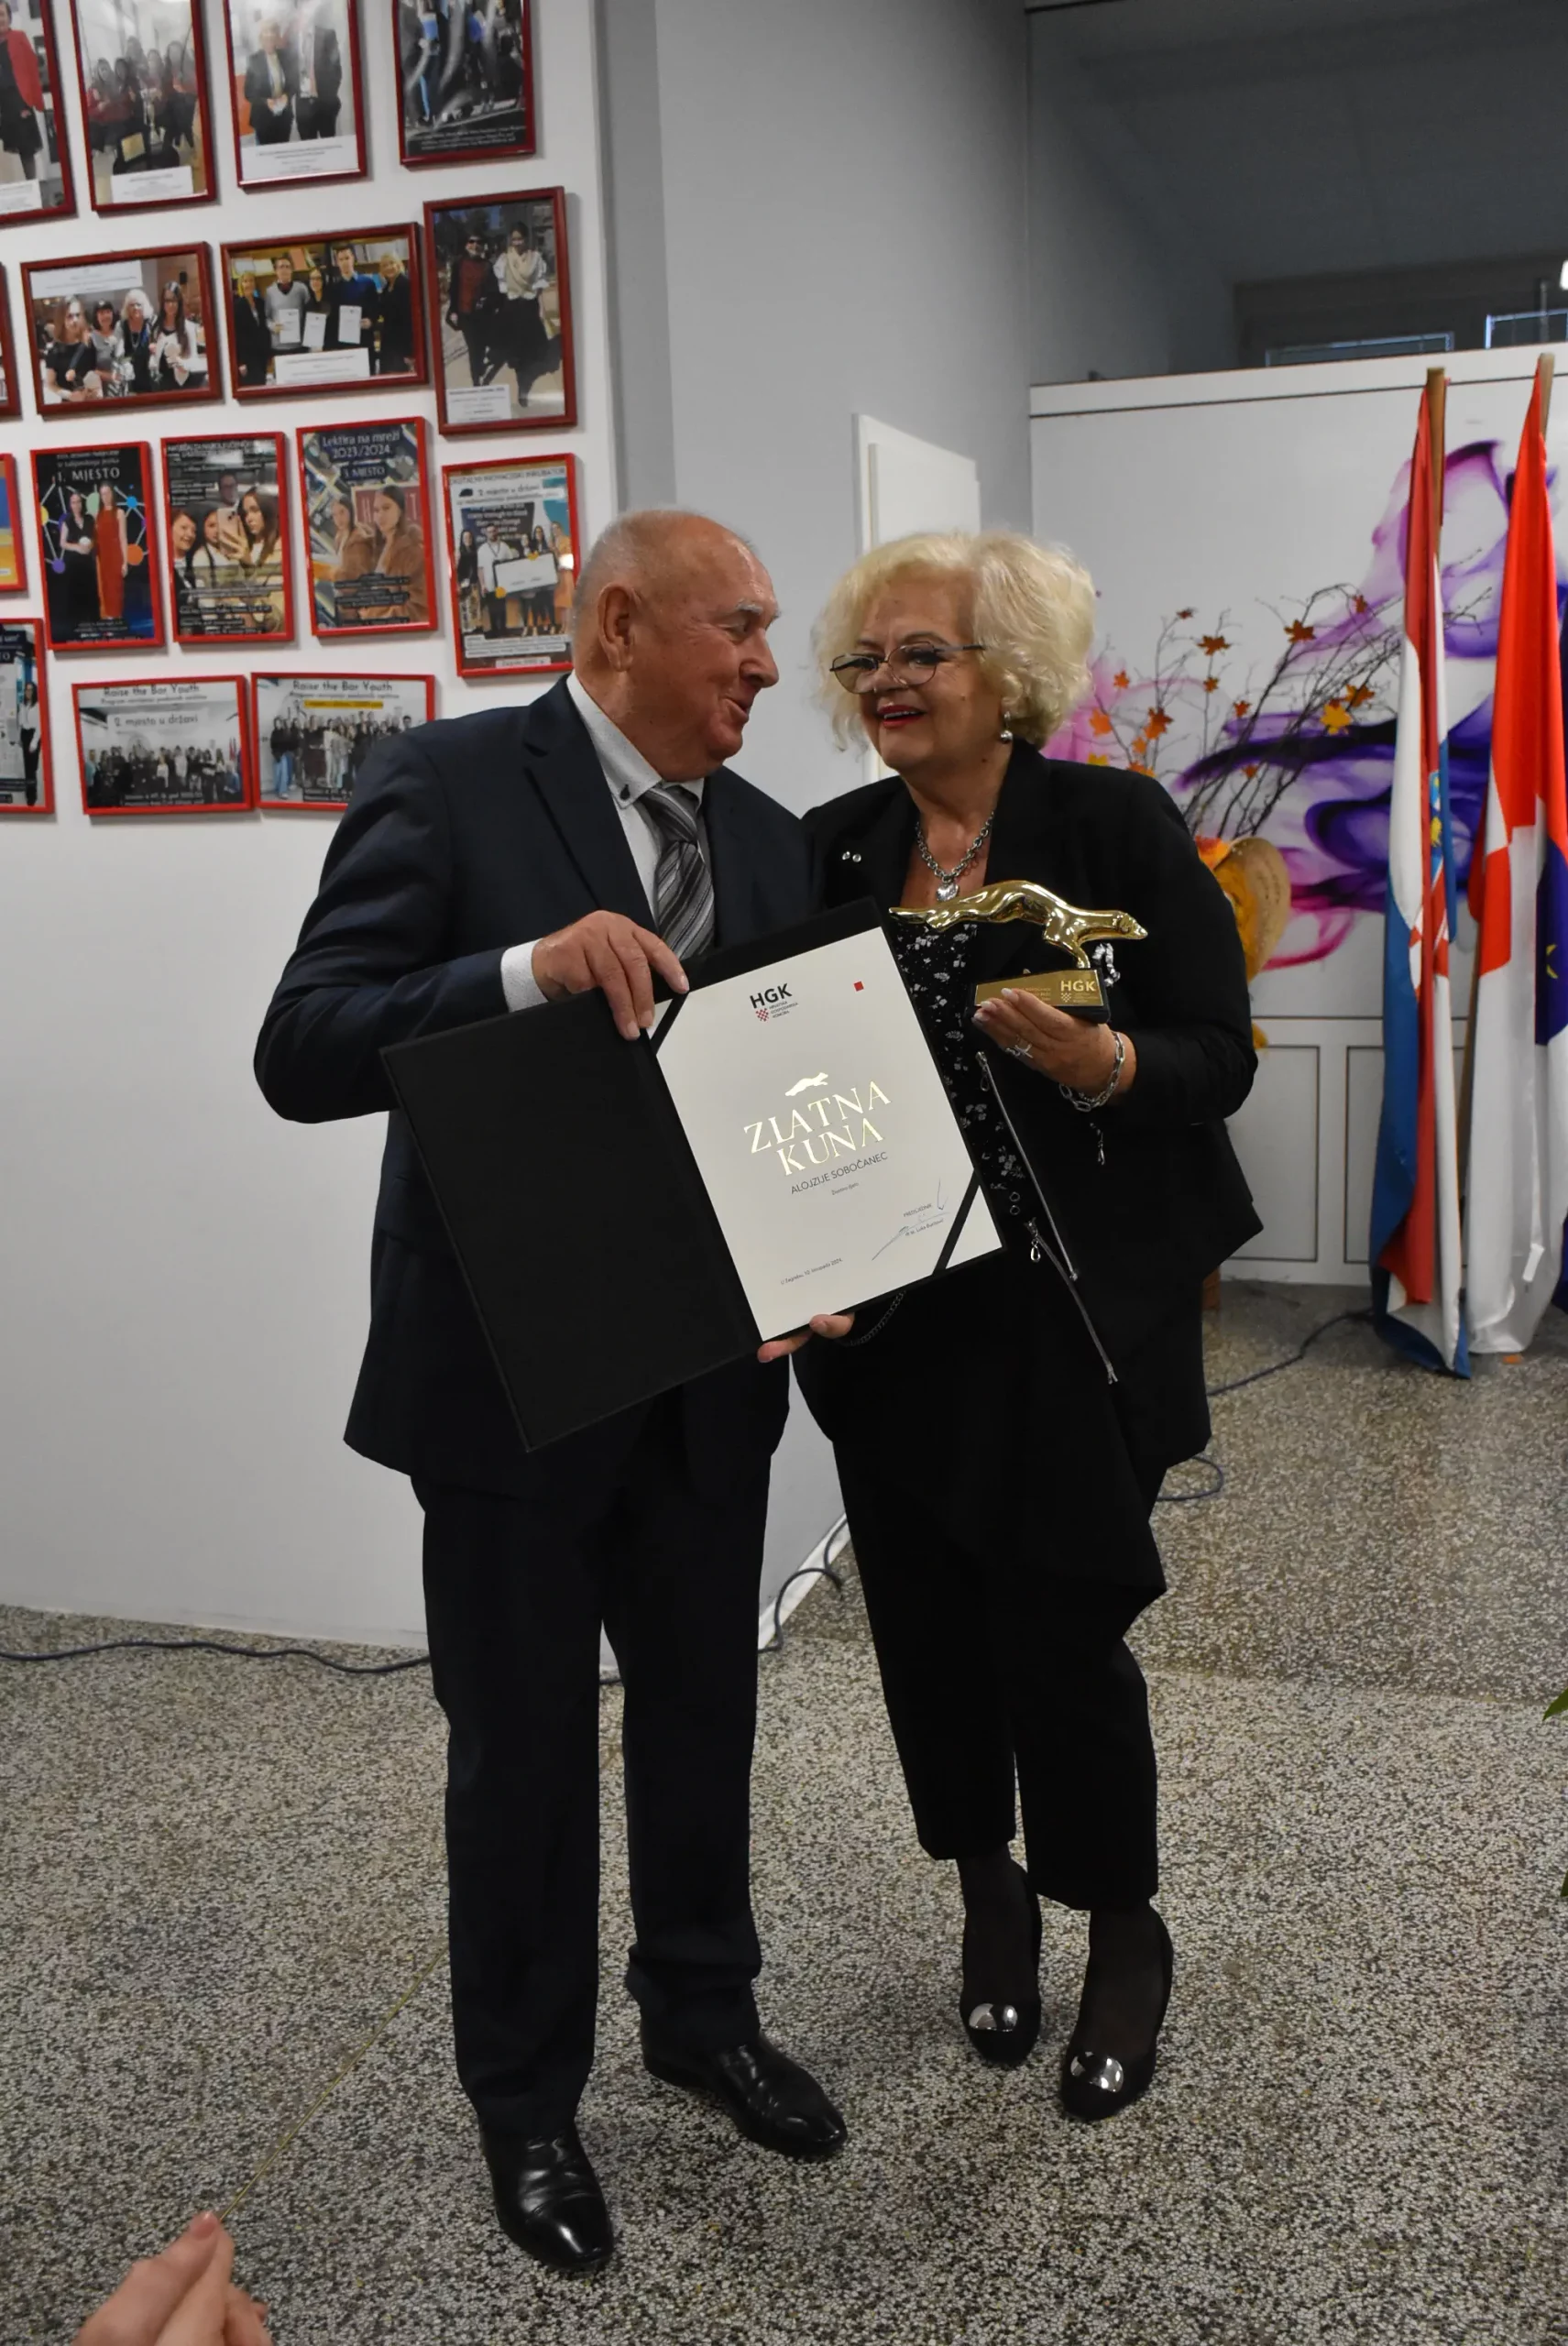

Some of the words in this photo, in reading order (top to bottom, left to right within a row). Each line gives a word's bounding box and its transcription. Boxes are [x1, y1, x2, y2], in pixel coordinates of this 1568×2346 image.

[322, 434, 356, 447] Lektira
[357, 435, 370, 444] na
[333, 445, 390, 459] 2023/2024
[71, 466, 120, 482] MJESTO
[104, 686, 128, 697] Raise
[133, 686, 148, 696] the
[151, 685, 167, 695] Bar
[170, 683, 200, 694] Youth
[293, 681, 320, 691] Raise
[323, 681, 338, 691] the
[342, 681, 358, 691] Bar
[363, 681, 392, 692] Youth
[126, 717, 157, 728] mjesto
[169, 714, 198, 725] državi
[1060, 981, 1096, 992] HGK
[750, 982, 793, 1009] HGK
[743, 1080, 891, 1154] ZLATNA
[776, 1117, 883, 1176] KUNA
[791, 1173, 830, 1195] ALOJZIJE
[831, 1151, 888, 1179] SOBOČANEC
